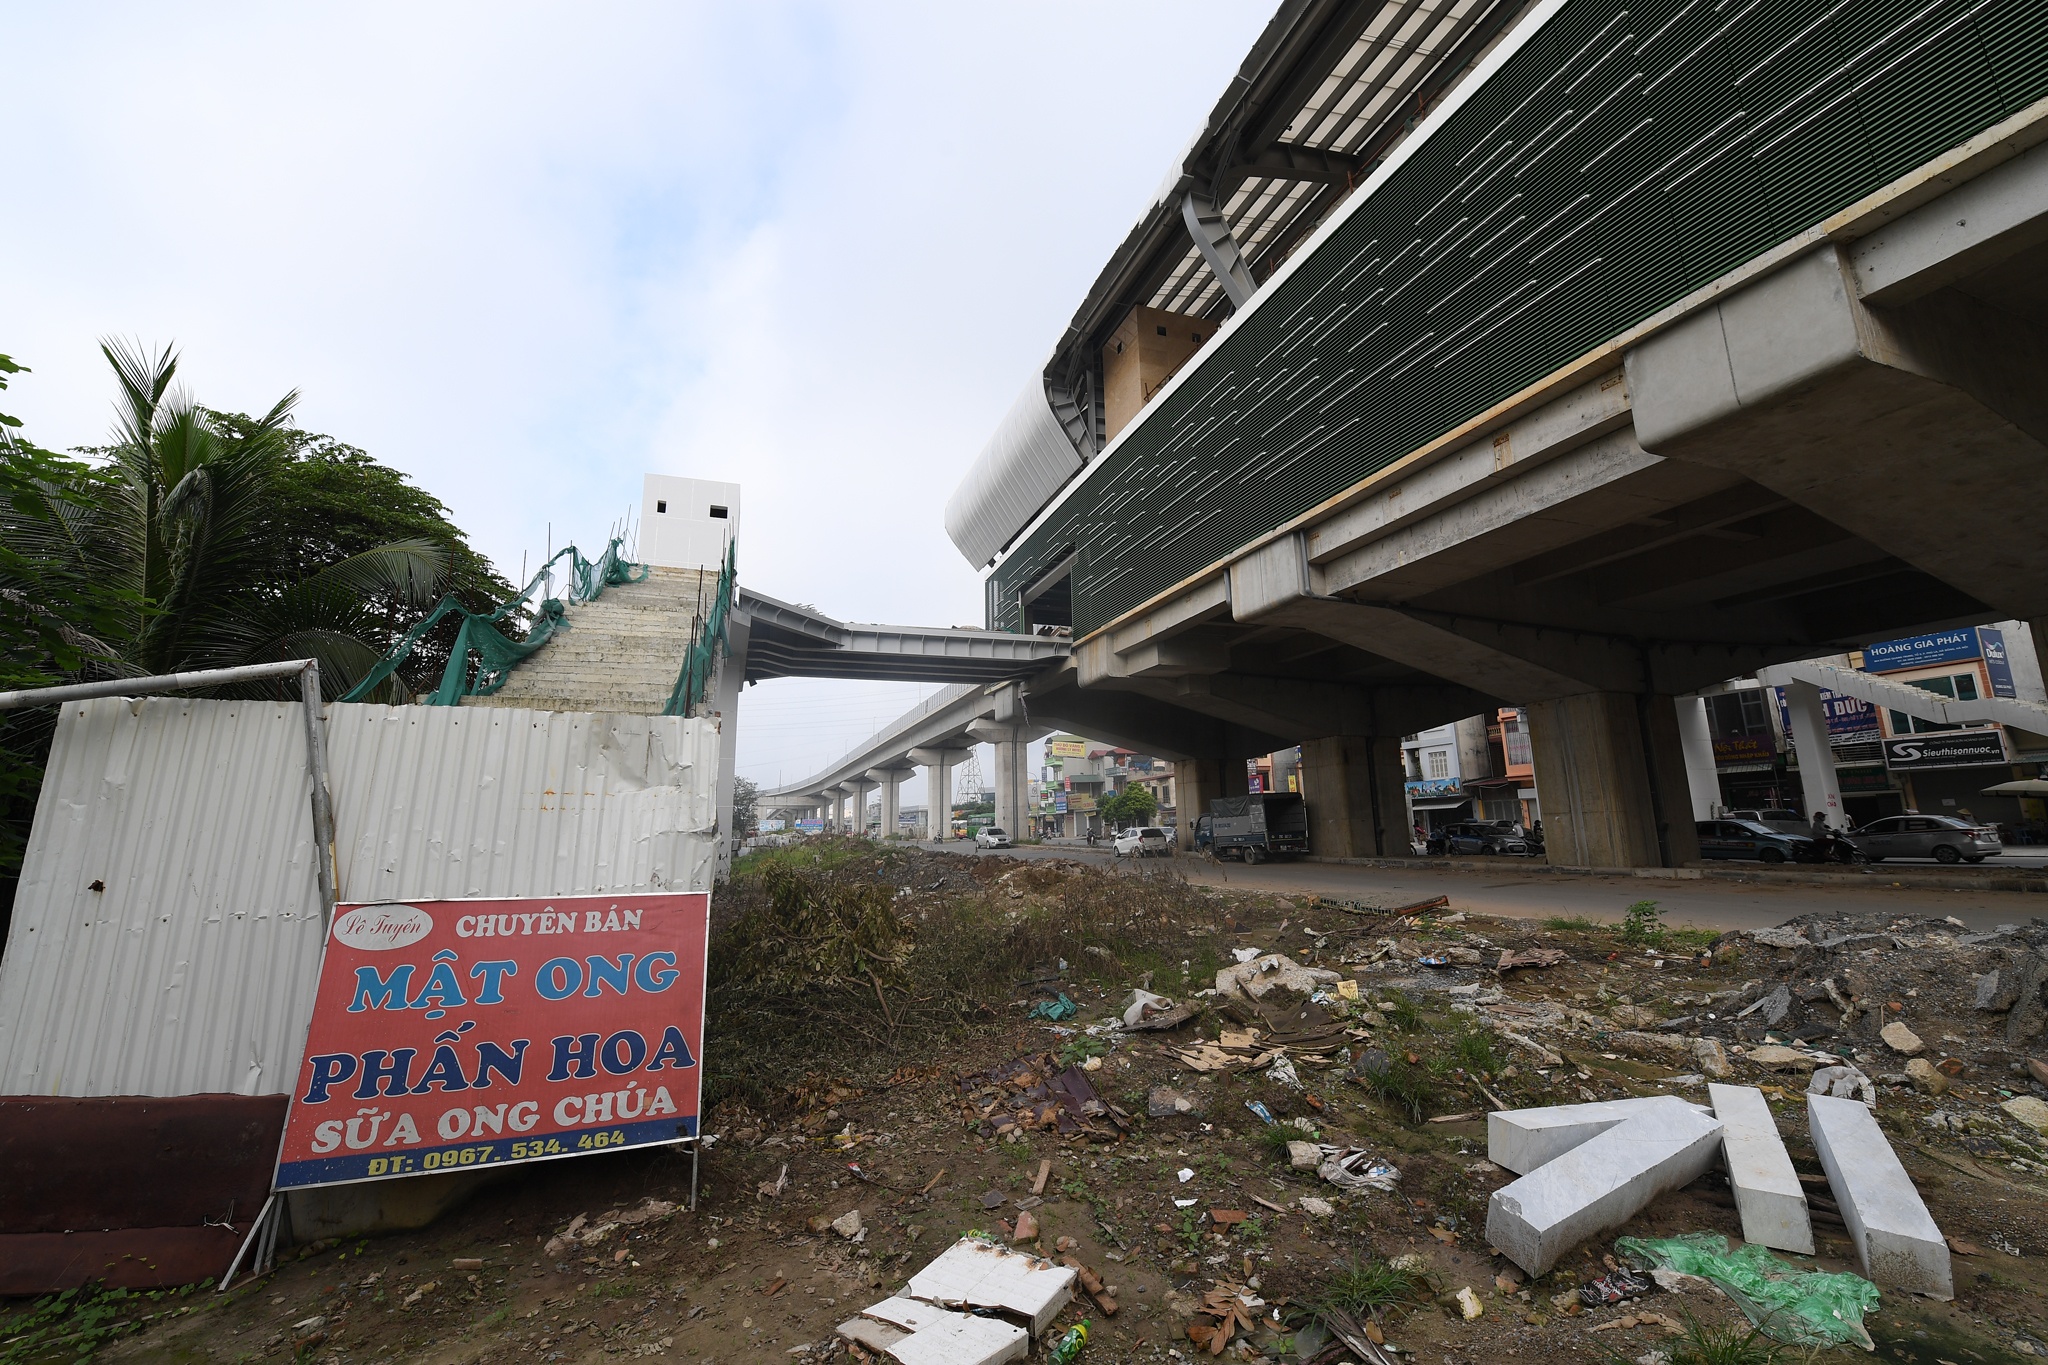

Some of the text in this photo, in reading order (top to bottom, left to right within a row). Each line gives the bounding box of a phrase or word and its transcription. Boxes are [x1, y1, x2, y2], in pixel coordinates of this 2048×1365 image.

[1871, 645, 1912, 656] HOÀNG
[1914, 640, 1934, 649] GIA
[1937, 633, 1968, 646] PHÁT
[1833, 697, 1868, 716] ĐỨC
[1922, 746, 2000, 758] Sieuthisonnuoc.vn
[344, 913, 422, 942] Lê Tuyến
[456, 904, 643, 937] CHUYÊN BÁN
[346, 948, 680, 1019] MẬT ONG
[301, 1020, 697, 1104] PHẤN HOA
[311, 1081, 678, 1154] SỮA ONG CHÚA
[367, 1129, 626, 1177] ĐT: 0967. 534. 464
